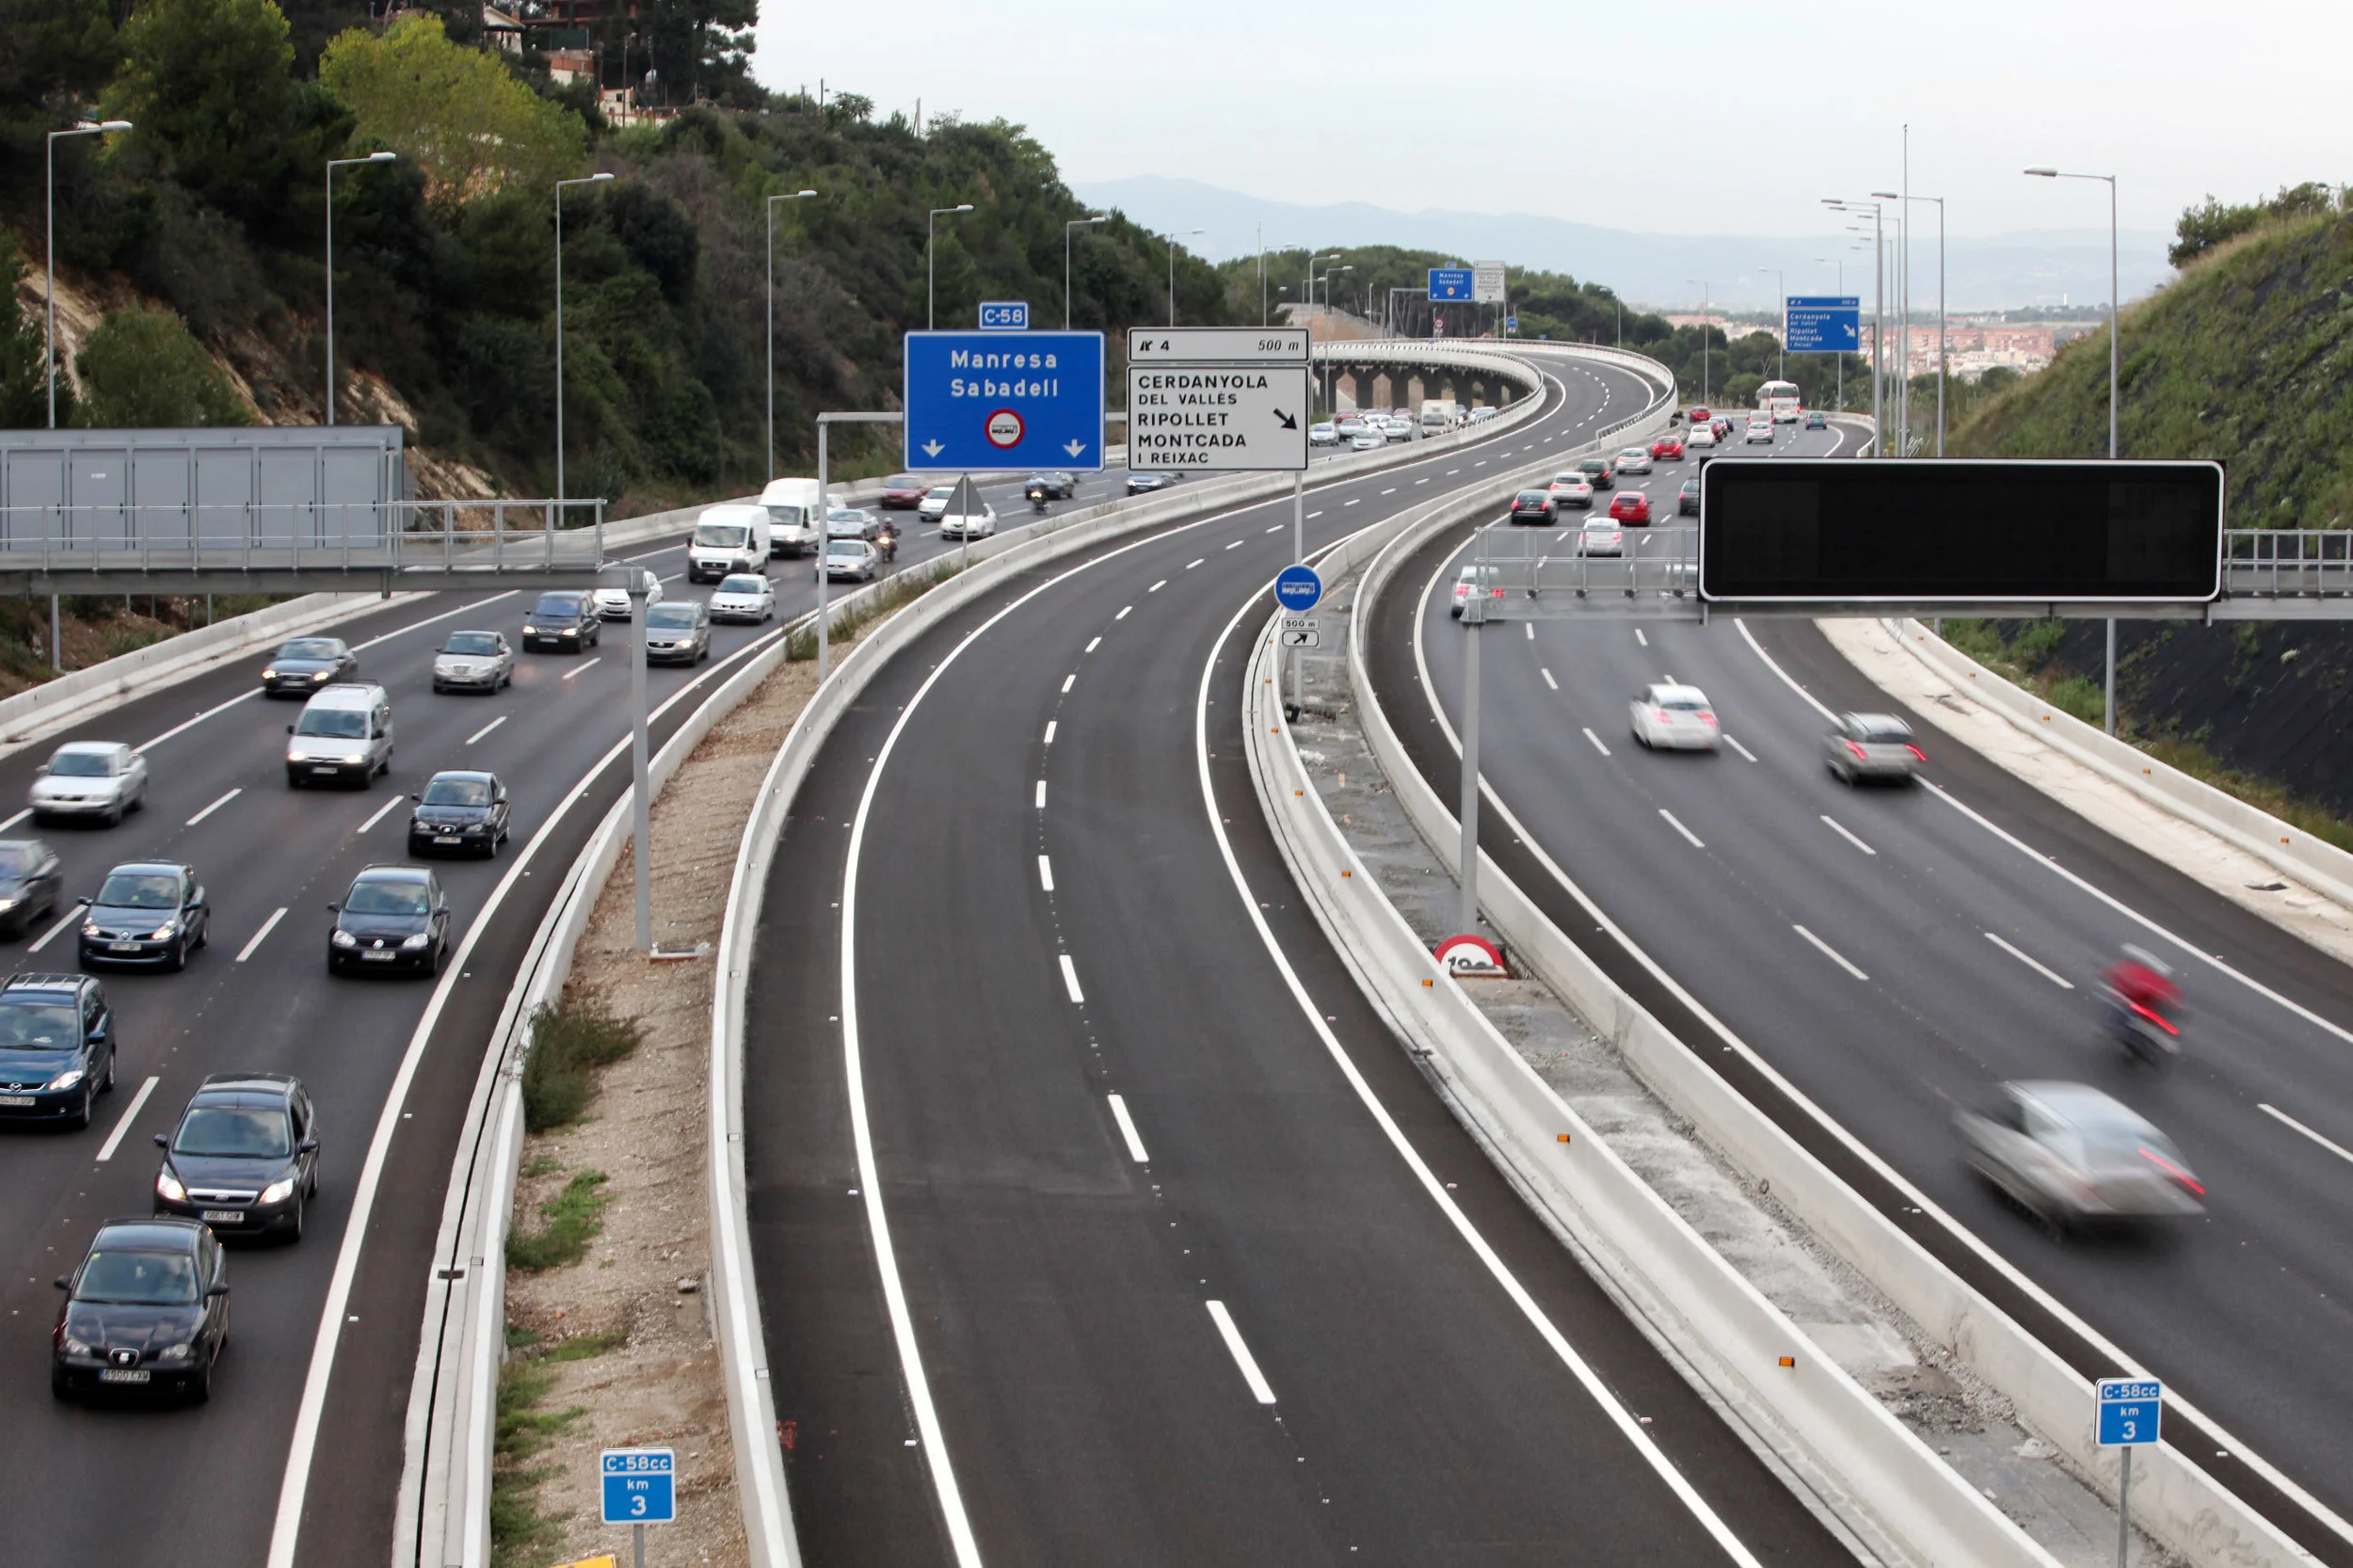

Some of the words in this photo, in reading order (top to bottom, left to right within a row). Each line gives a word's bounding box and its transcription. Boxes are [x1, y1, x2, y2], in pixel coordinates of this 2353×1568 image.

[984, 309, 1023, 323] C-58
[1160, 340, 1170, 351] 4
[1258, 340, 1282, 351] 500
[1289, 341, 1299, 351] m
[951, 350, 1057, 368] Manresa
[951, 378, 1058, 396] Sabadell
[1138, 376, 1268, 389] CERDANYOLA
[1138, 393, 1168, 405] DEL
[1178, 392, 1238, 405] VALLÈS
[1138, 413, 1228, 426] RIPOLLET
[1138, 434, 1247, 447] MONTCADA
[1138, 453, 1142, 463] I
[1151, 453, 1209, 463] REIXAC
[2104, 1384, 2157, 1399] C-58cc
[2121, 1406, 2139, 1416] km
[2121, 1421, 2137, 1440] 3
[606, 1456, 669, 1471] C-58cc
[627, 1479, 649, 1491] km
[631, 1495, 647, 1516] 3
